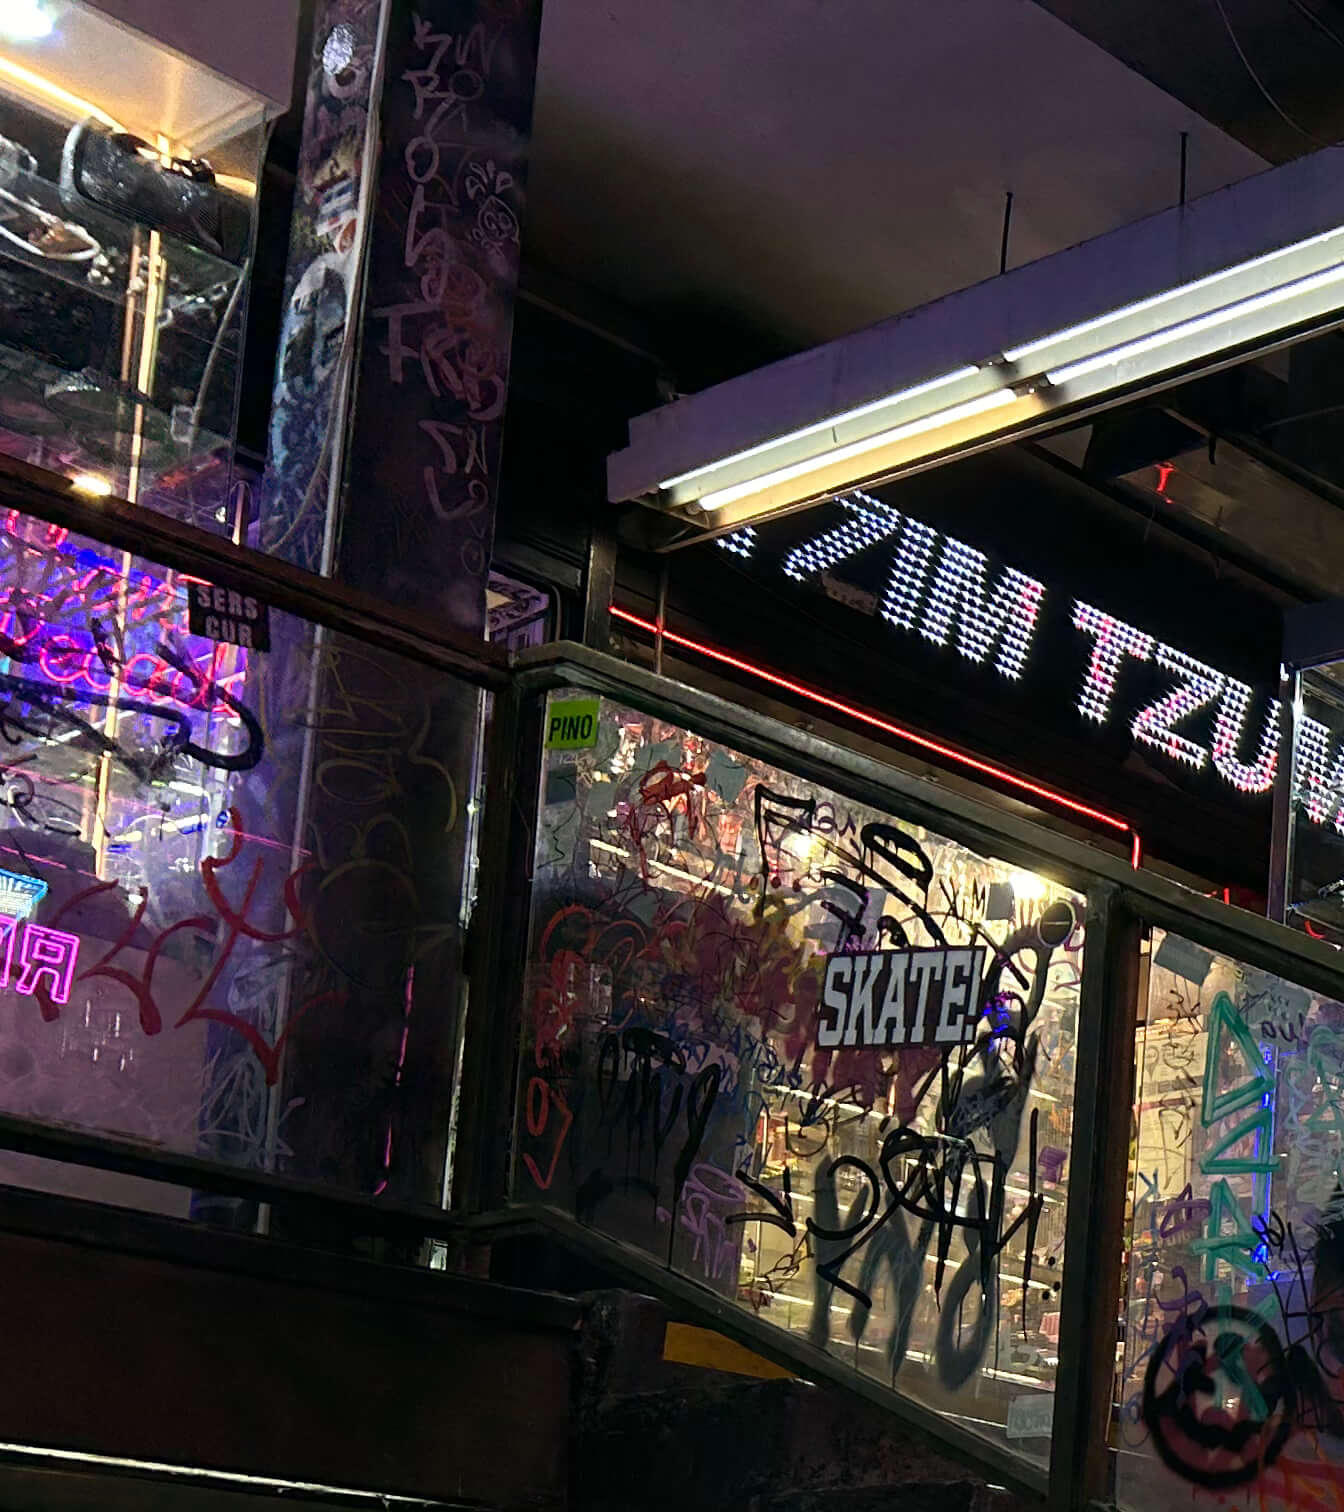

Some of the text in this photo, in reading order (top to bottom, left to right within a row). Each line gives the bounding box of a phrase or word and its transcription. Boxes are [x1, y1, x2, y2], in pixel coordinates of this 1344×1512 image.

[715, 488, 1046, 682] ZIM
[549, 714, 593, 741] PINO
[820, 949, 984, 1046] SKATE!
